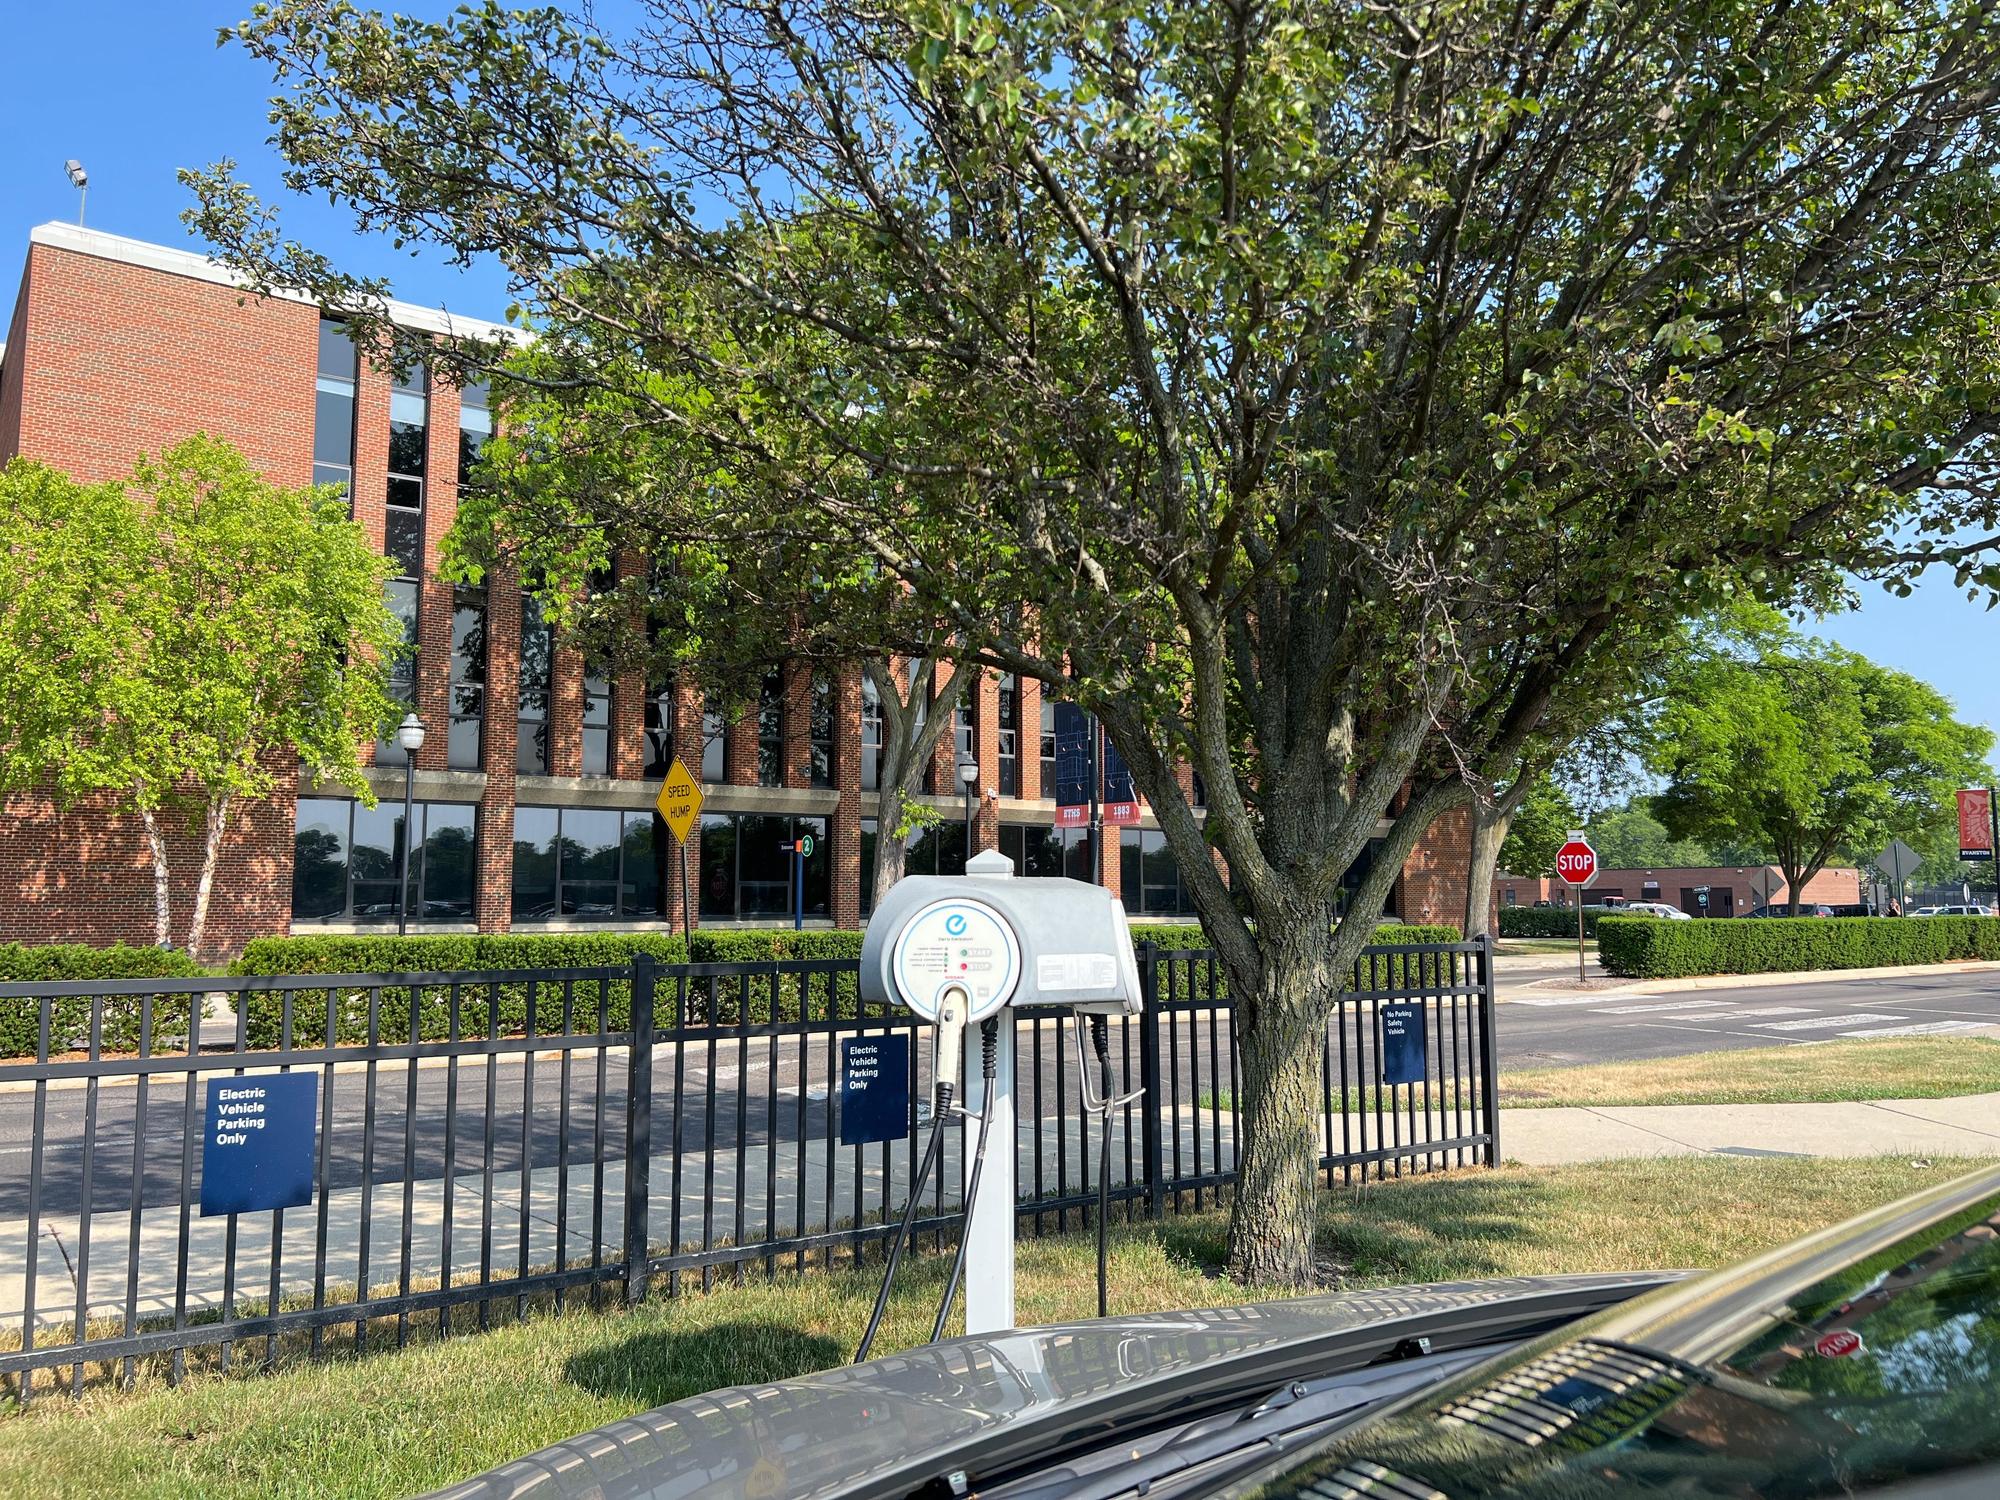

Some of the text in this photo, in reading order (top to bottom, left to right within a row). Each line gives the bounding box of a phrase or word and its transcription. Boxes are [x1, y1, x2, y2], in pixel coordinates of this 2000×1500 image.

[668, 784, 691, 798] SPEED
[670, 804, 691, 818] HUMP
[1113, 805, 1130, 815] 1883
[804, 840, 810, 851] 2
[1559, 854, 1592, 870] STOP
[1395, 1010, 1412, 1018] Parking
[1387, 1019, 1402, 1027] Safety
[849, 1045, 878, 1055] Electric
[849, 1056, 878, 1067] Vehicle
[849, 1068, 879, 1078] Parking
[849, 1080, 868, 1090] Only
[219, 1087, 266, 1101] Electric
[218, 1102, 265, 1115] Vehicle
[217, 1118, 266, 1130] Parking
[216, 1132, 247, 1146] Only
